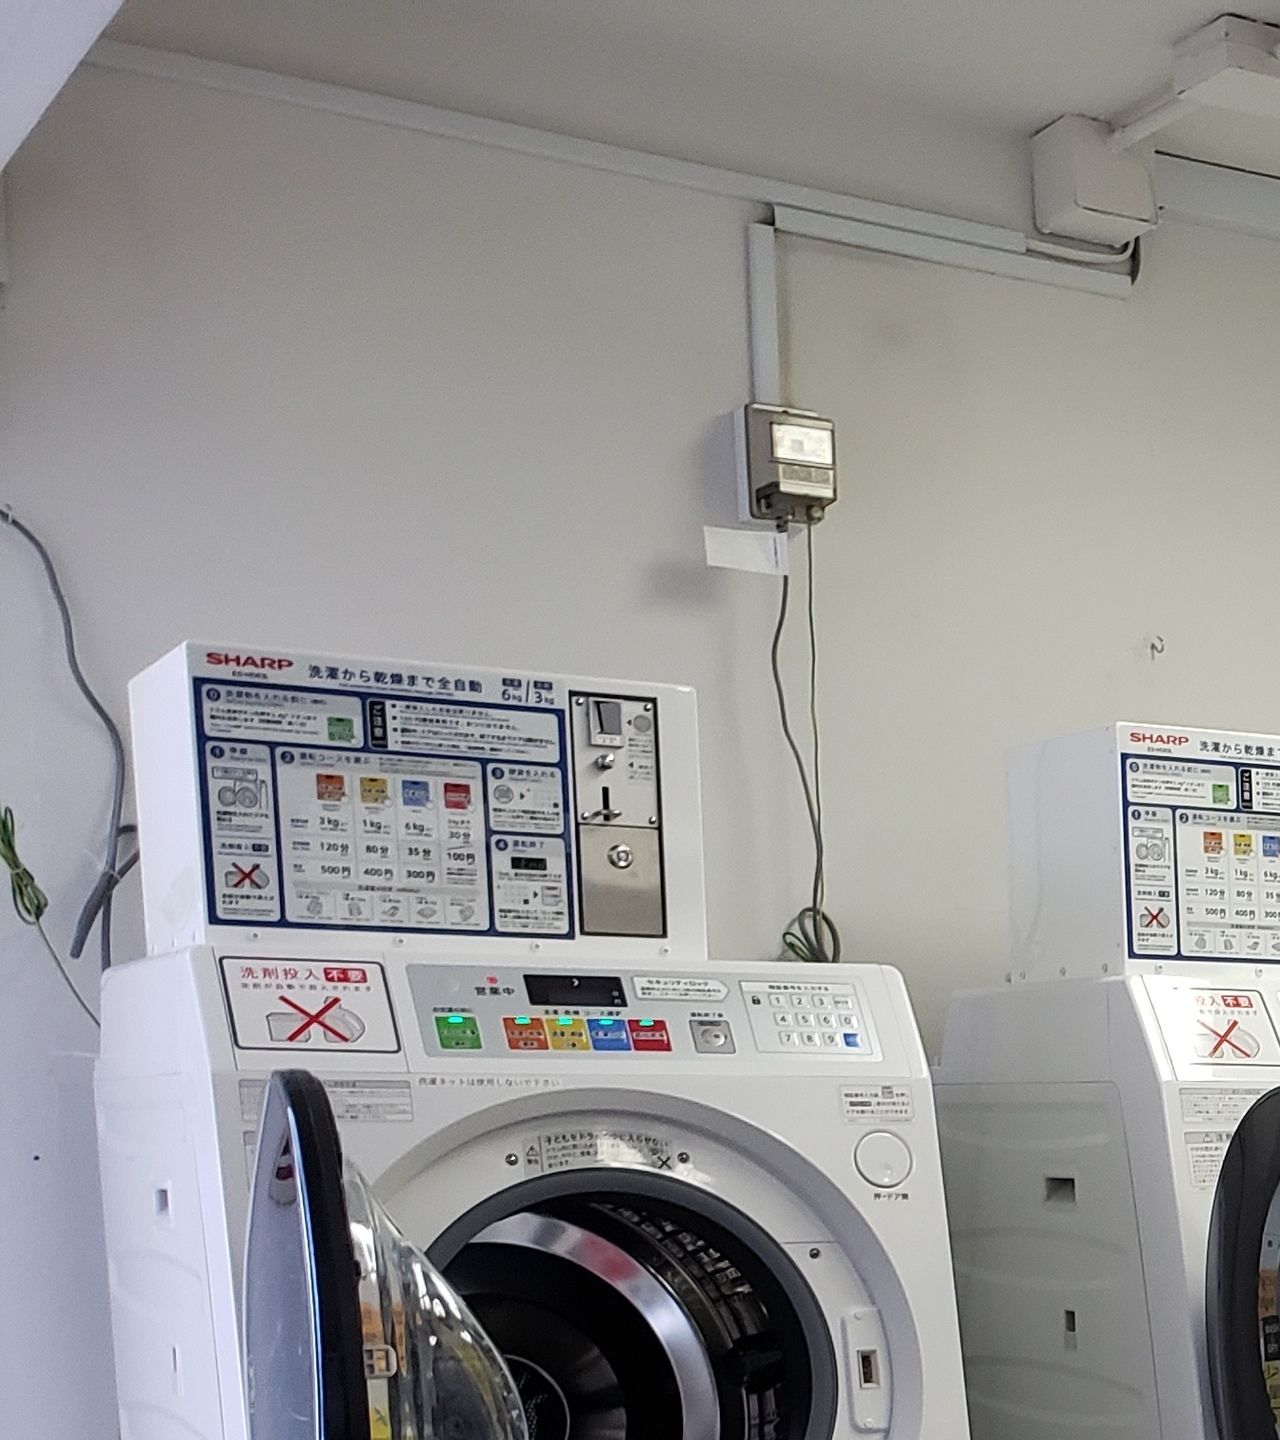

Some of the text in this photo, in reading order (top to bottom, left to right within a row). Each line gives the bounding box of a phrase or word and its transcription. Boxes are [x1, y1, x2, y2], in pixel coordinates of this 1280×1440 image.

[206, 652, 294, 670] SHARP
[308, 664, 483, 693] 洗濯から乾燥まで全自動
[1130, 732, 1189, 746] SHARP
